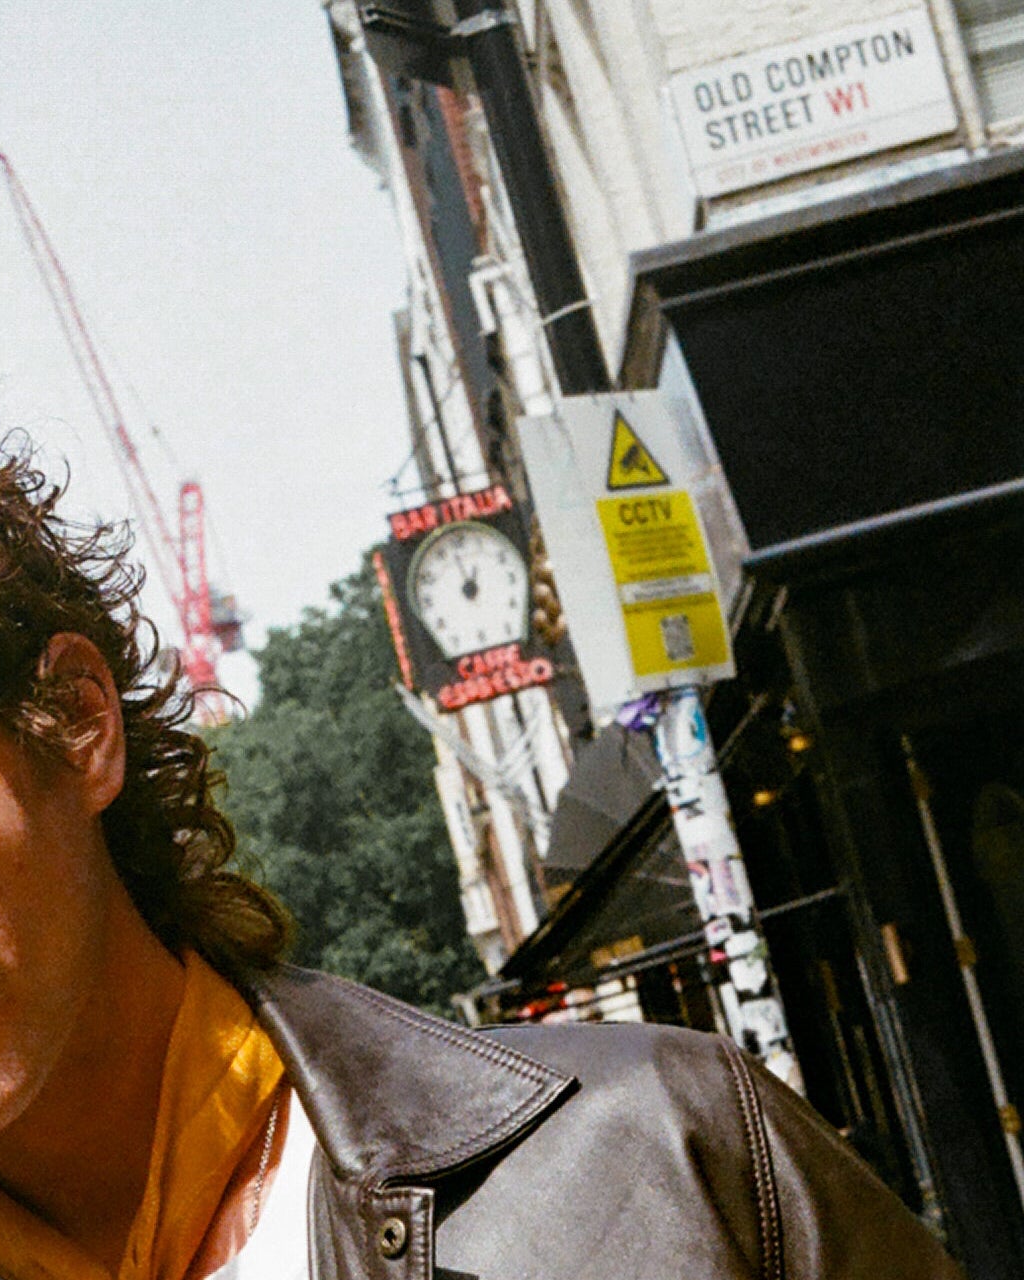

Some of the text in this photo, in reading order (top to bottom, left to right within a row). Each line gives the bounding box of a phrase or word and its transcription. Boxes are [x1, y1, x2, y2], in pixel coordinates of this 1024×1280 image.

[694, 28, 915, 113] OLD COMPTON
[705, 81, 869, 150] STREET W1
[618, 500, 672, 526] CCTV
